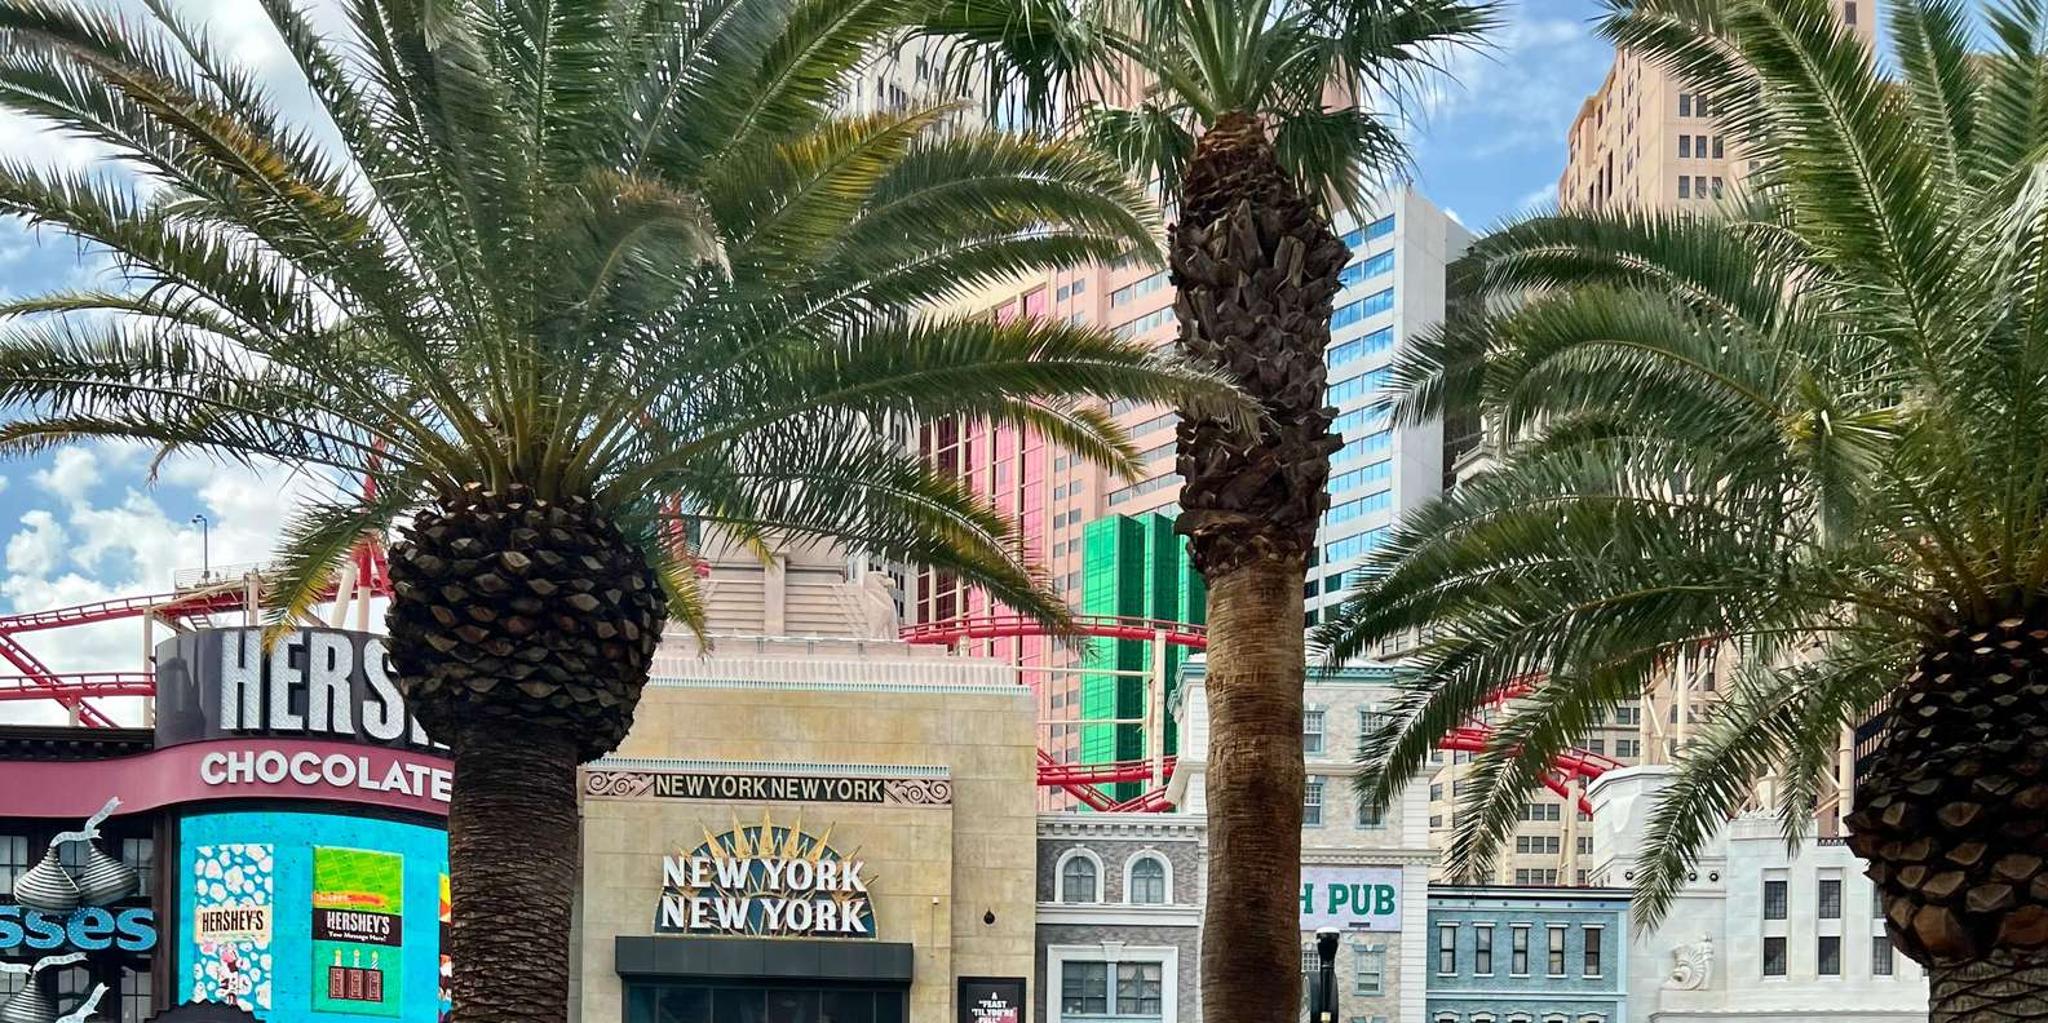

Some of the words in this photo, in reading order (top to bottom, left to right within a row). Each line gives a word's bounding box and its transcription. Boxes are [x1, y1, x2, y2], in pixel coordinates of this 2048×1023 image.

[220, 629, 451, 750] HERS
[200, 750, 452, 803] CHOCOLATE
[663, 855, 751, 889] NEW
[761, 857, 868, 892] YORK
[661, 895, 750, 929] NEW
[759, 897, 868, 933] YORK
[1327, 883, 1395, 916] PUB
[202, 910, 263, 933] HERSHEY'S
[326, 911, 390, 935] HERSHEY'S
[991, 991, 998, 1000] A
